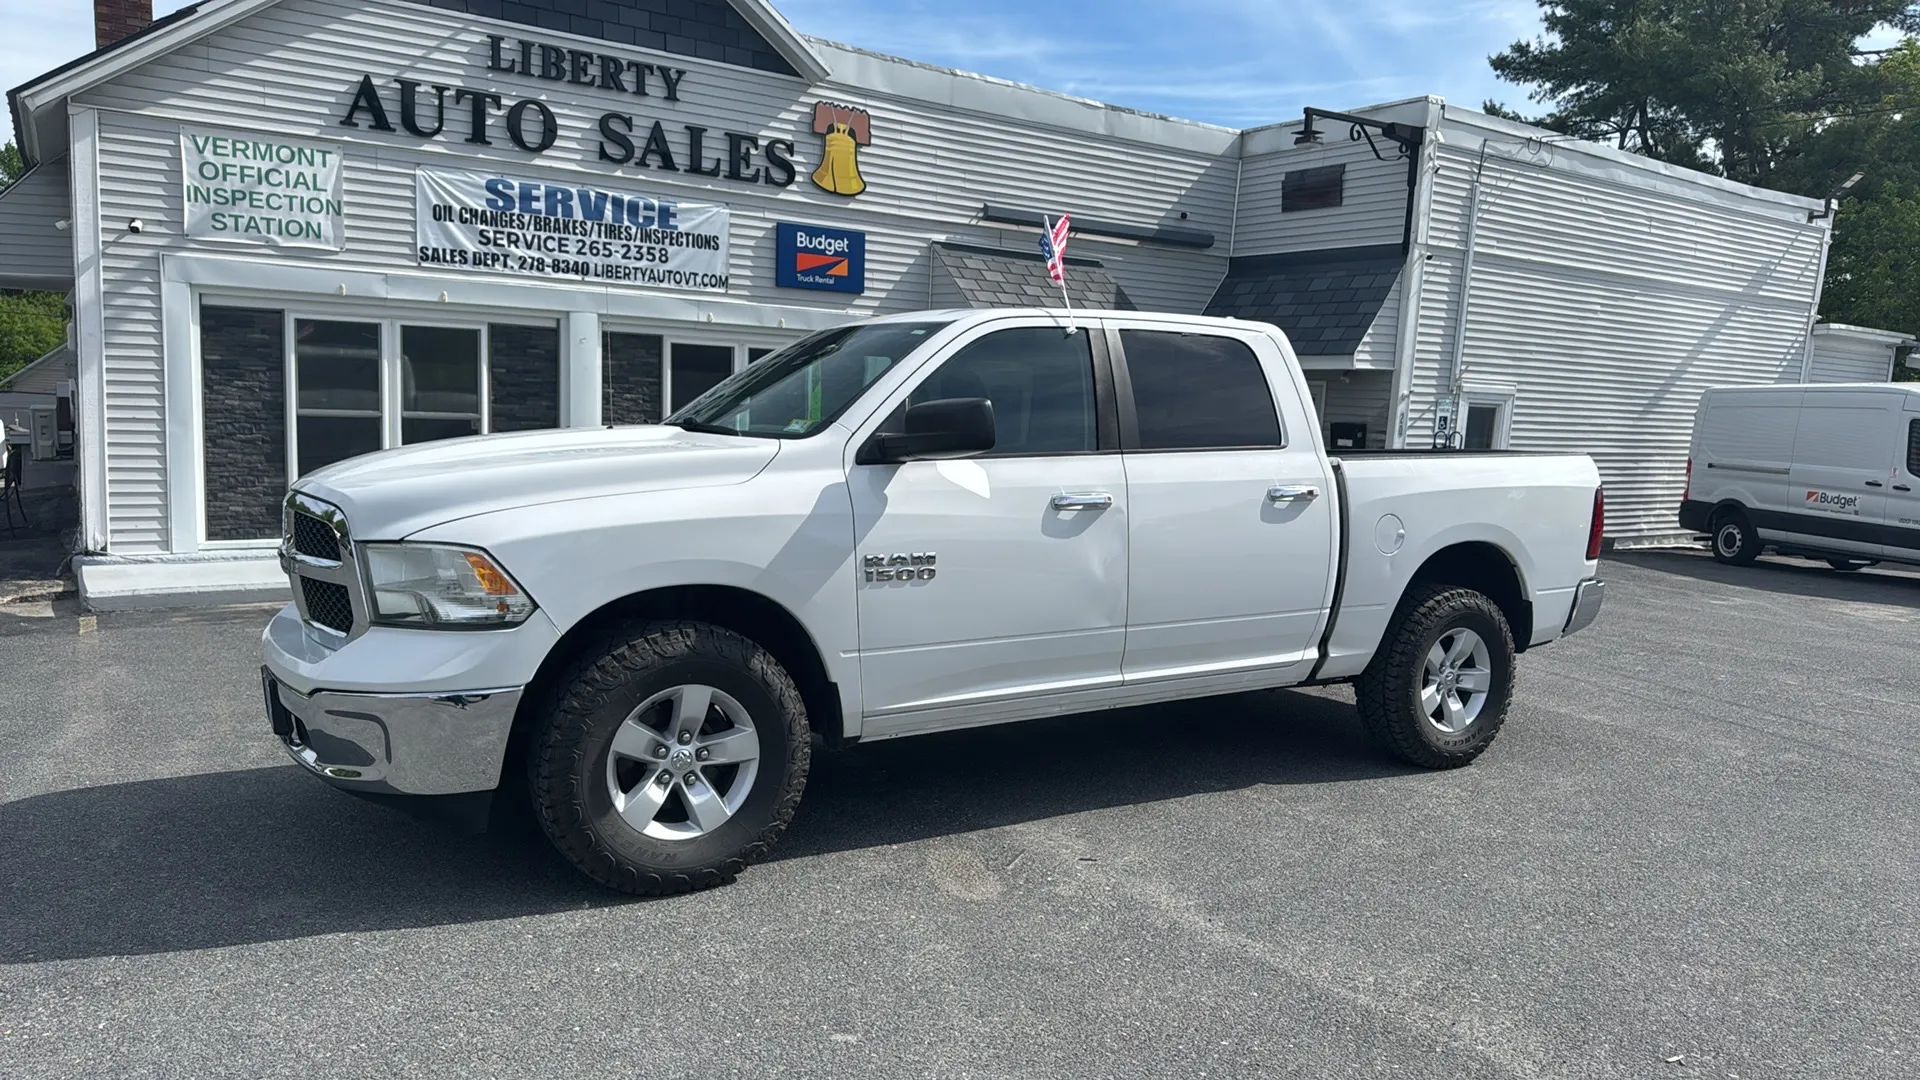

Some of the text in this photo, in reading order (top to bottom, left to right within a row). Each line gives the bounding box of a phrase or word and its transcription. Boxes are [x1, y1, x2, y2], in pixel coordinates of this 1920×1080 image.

[486, 34, 687, 101] LIBERTY
[339, 74, 797, 187] AUTO SALES
[190, 134, 332, 168] VERMONT
[198, 161, 328, 192] OFFICIAL
[186, 184, 342, 216] INSPECTION
[432, 204, 454, 222] OIL
[485, 178, 679, 230] SERVICE
[211, 212, 322, 240] STATION
[478, 229, 669, 264] SERVICE 265-2358
[796, 231, 849, 255] Budget
[419, 246, 729, 289] SALES DEPT. 278-8340 LIBERTYAUTOVT.COM
[796, 273, 835, 285] Truck Rental
[1819, 492, 1858, 509] Budget
[864, 552, 937, 567] RAM
[864, 566, 937, 583] 1500
